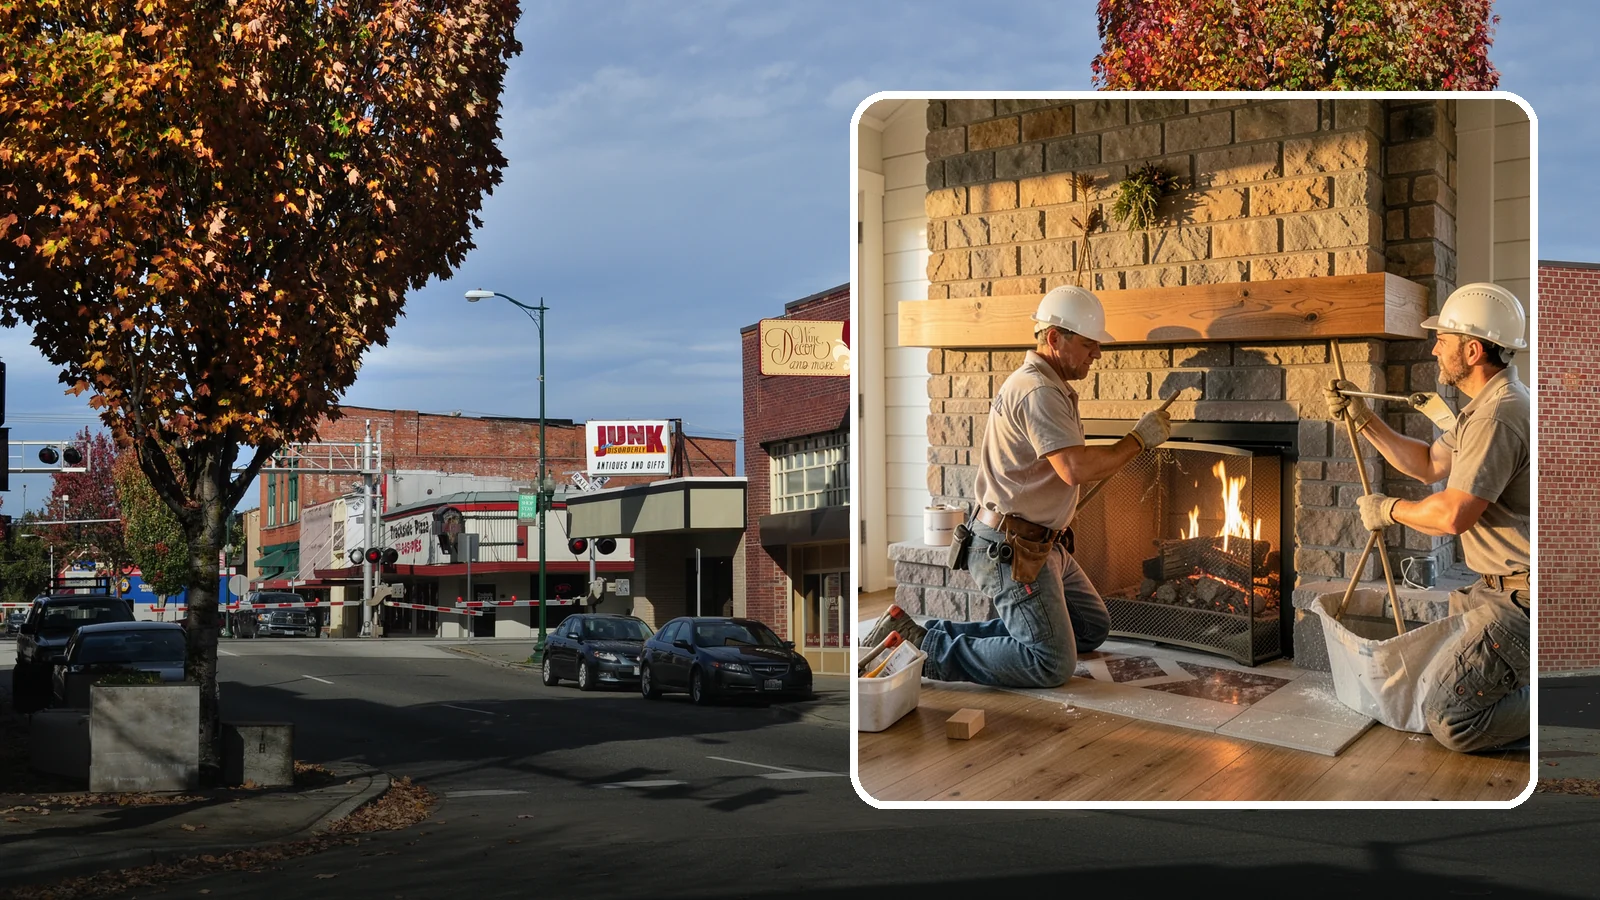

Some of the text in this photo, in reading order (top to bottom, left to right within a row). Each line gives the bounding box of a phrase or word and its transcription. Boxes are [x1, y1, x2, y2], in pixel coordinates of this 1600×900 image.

[596, 425, 664, 457] JUNK
[607, 446, 646, 454] DISORDERLY
[597, 460, 665, 470] ANTIQUES AND GIFTS
[414, 519, 429, 535] Pizza
